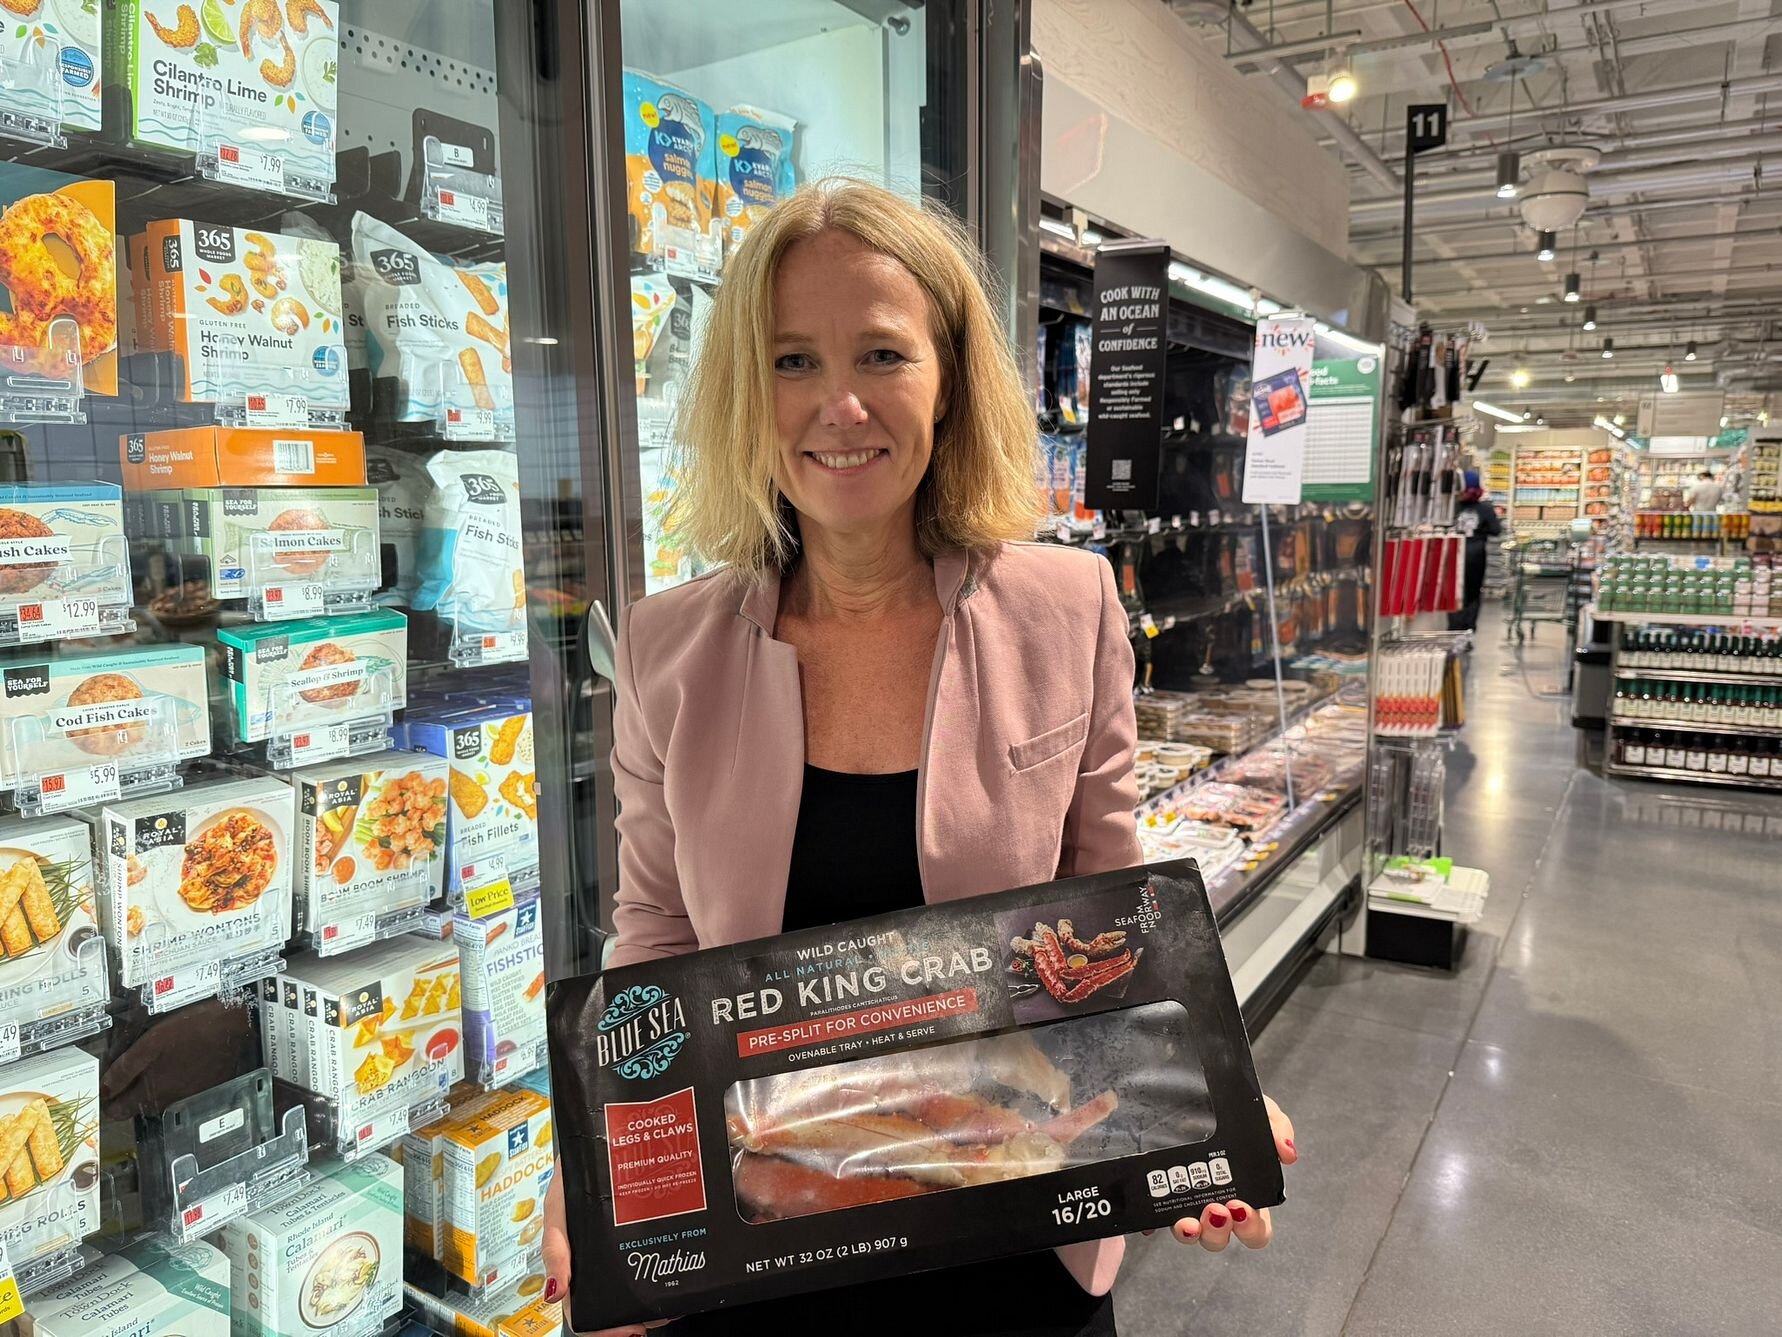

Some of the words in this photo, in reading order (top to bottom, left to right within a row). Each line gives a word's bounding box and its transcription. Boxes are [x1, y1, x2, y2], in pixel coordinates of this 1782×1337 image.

[153, 60, 222, 91] Cilantro
[227, 79, 267, 103] Lime
[153, 78, 216, 110] Shrimp
[1411, 112, 1440, 138] 11
[260, 153, 281, 174] $7.99
[198, 229, 231, 251] 365
[168, 239, 180, 268] 365
[376, 253, 415, 273] 365
[1100, 286, 1129, 304] COOK
[1131, 286, 1160, 300] WITH
[385, 302, 420, 310] BREADED
[1100, 306, 1117, 321] AN
[1119, 304, 1160, 320] OCEAN
[200, 319, 228, 329] GLUTEN
[230, 321, 247, 329] FREE
[387, 315, 416, 329] Fish
[419, 315, 459, 331] Sticks
[1122, 323, 1135, 336] of
[201, 330, 245, 347] Honey
[248, 334, 293, 349] Walnut
[1098, 337, 1158, 352] CONFIDENCE
[1261, 332, 1310, 348] new
[201, 345, 249, 363] Shrimp
[286, 399, 307, 414] $7.99
[128, 438, 144, 454] 365
[149, 451, 170, 464] Honey
[171, 450, 194, 462] Walnut
[150, 464, 173, 476] Shrimp
[468, 478, 500, 496] 365
[260, 537, 305, 549] Salmon
[307, 536, 342, 547] Cakes
[465, 525, 493, 542] Fish
[24, 545, 68, 557] Cakes
[302, 586, 323, 601] $8.99
[63, 601, 96, 619] $12.99
[7, 681, 49, 692] YOURSELF
[291, 674, 322, 688] Scallop
[331, 667, 363, 681] Shrimp
[55, 714, 83, 728] Cod
[86, 711, 115, 721] Fish
[329, 728, 348, 743] $8.99
[456, 731, 480, 750] 365
[90, 766, 116, 785] $5.99
[328, 790, 356, 800] ROYAL
[331, 796, 351, 805] ASIA
[142, 826, 177, 841] ROYAL
[460, 822, 486, 835] BREADED
[462, 832, 484, 847] Fish
[487, 822, 519, 841] Fillets
[149, 834, 174, 845] ASIA
[321, 886, 350, 903] BOOM
[471, 894, 487, 907] Low
[488, 889, 510, 902] Price
[1139, 886, 1157, 929] NORWAY
[356, 914, 374, 931] $7.49
[1114, 911, 1162, 927] SEAFOOD
[1136, 904, 1150, 934] FROM
[133, 935, 187, 954] SHRIMP
[192, 913, 261, 939] WONTONS
[797, 944, 834, 961] WILD
[837, 932, 896, 952] CAUGHT
[39, 967, 87, 990] ROLLS
[195, 962, 219, 981] $7.49
[765, 970, 790, 983] ALL
[796, 955, 864, 976] NATURAL
[82, 985, 90, 996] 5
[711, 988, 783, 1025] RED
[798, 966, 887, 1008] KING
[901, 947, 993, 986] CRAB
[352, 998, 377, 1013] ROYAL
[355, 1005, 375, 1017] ASIA
[288, 1012, 296, 1039] CRAB
[749, 1024, 821, 1050] PRE-SPLIT
[826, 1017, 857, 1034] FOR
[860, 994, 967, 1028] CONVENIENCE
[596, 1015, 646, 1067] BLUE
[649, 997, 687, 1041] SEA
[329, 1029, 337, 1056] CRAB
[788, 1045, 838, 1063] OVENABLE
[839, 1040, 864, 1053] TRAY
[871, 1032, 896, 1046] HEAT
[898, 1030, 905, 1041] &
[906, 1025, 936, 1039] SERVE
[351, 1089, 384, 1112] CRAB
[388, 1058, 445, 1094] RANGOON
[480, 1095, 526, 1121] HADDOCK
[219, 1118, 225, 1129] E
[627, 1113, 677, 1132] COOKED
[612, 1133, 642, 1148] LEGS
[643, 1131, 651, 1140] &
[653, 1122, 694, 1139] CLAWS
[617, 1158, 655, 1171] PREMIUM
[657, 1150, 694, 1163] QUALITY
[480, 1152, 553, 1200] HADDOCK
[618, 1178, 656, 1191] INDIVIDUALLY
[656, 1174, 674, 1184] QUICK
[675, 1170, 697, 1180] FROZEN
[1151, 1174, 1164, 1185] 82
[223, 1186, 245, 1206] $7.49
[1058, 1186, 1100, 1204] LARGE
[1184, 1198, 1215, 1208] CHOLESTEROL
[1216, 1193, 1237, 1202] CONTENT
[281, 1215, 304, 1229] Tubes
[306, 1211, 312, 1219] &
[312, 1191, 346, 1213] Tentacles
[285, 1193, 327, 1218] Calamari
[1051, 1199, 1112, 1225] 16/20
[79, 1217, 86, 1228] 5
[287, 1227, 310, 1243] Rhode
[312, 1212, 334, 1231] Island
[285, 1218, 344, 1258] Calamari
[619, 1232, 679, 1251] EXCLUSIVELY
[682, 1227, 707, 1240] FROM
[746, 1259, 770, 1273] NET
[774, 1255, 795, 1268] WT
[799, 1252, 813, 1264] 32
[816, 1249, 833, 1260] OZ
[836, 1246, 849, 1258] (2
[851, 1241, 872, 1255] LB)
[874, 1236, 896, 1250] 907
[899, 1236, 908, 1248] g
[627, 1249, 706, 1283] Mathias
[56, 1272, 109, 1301] Calamari
[73, 1284, 103, 1301] Tubes
[60, 1280, 133, 1320] TownDock
[81, 1291, 134, 1321] Calamari
[99, 1304, 129, 1320] Tubes
